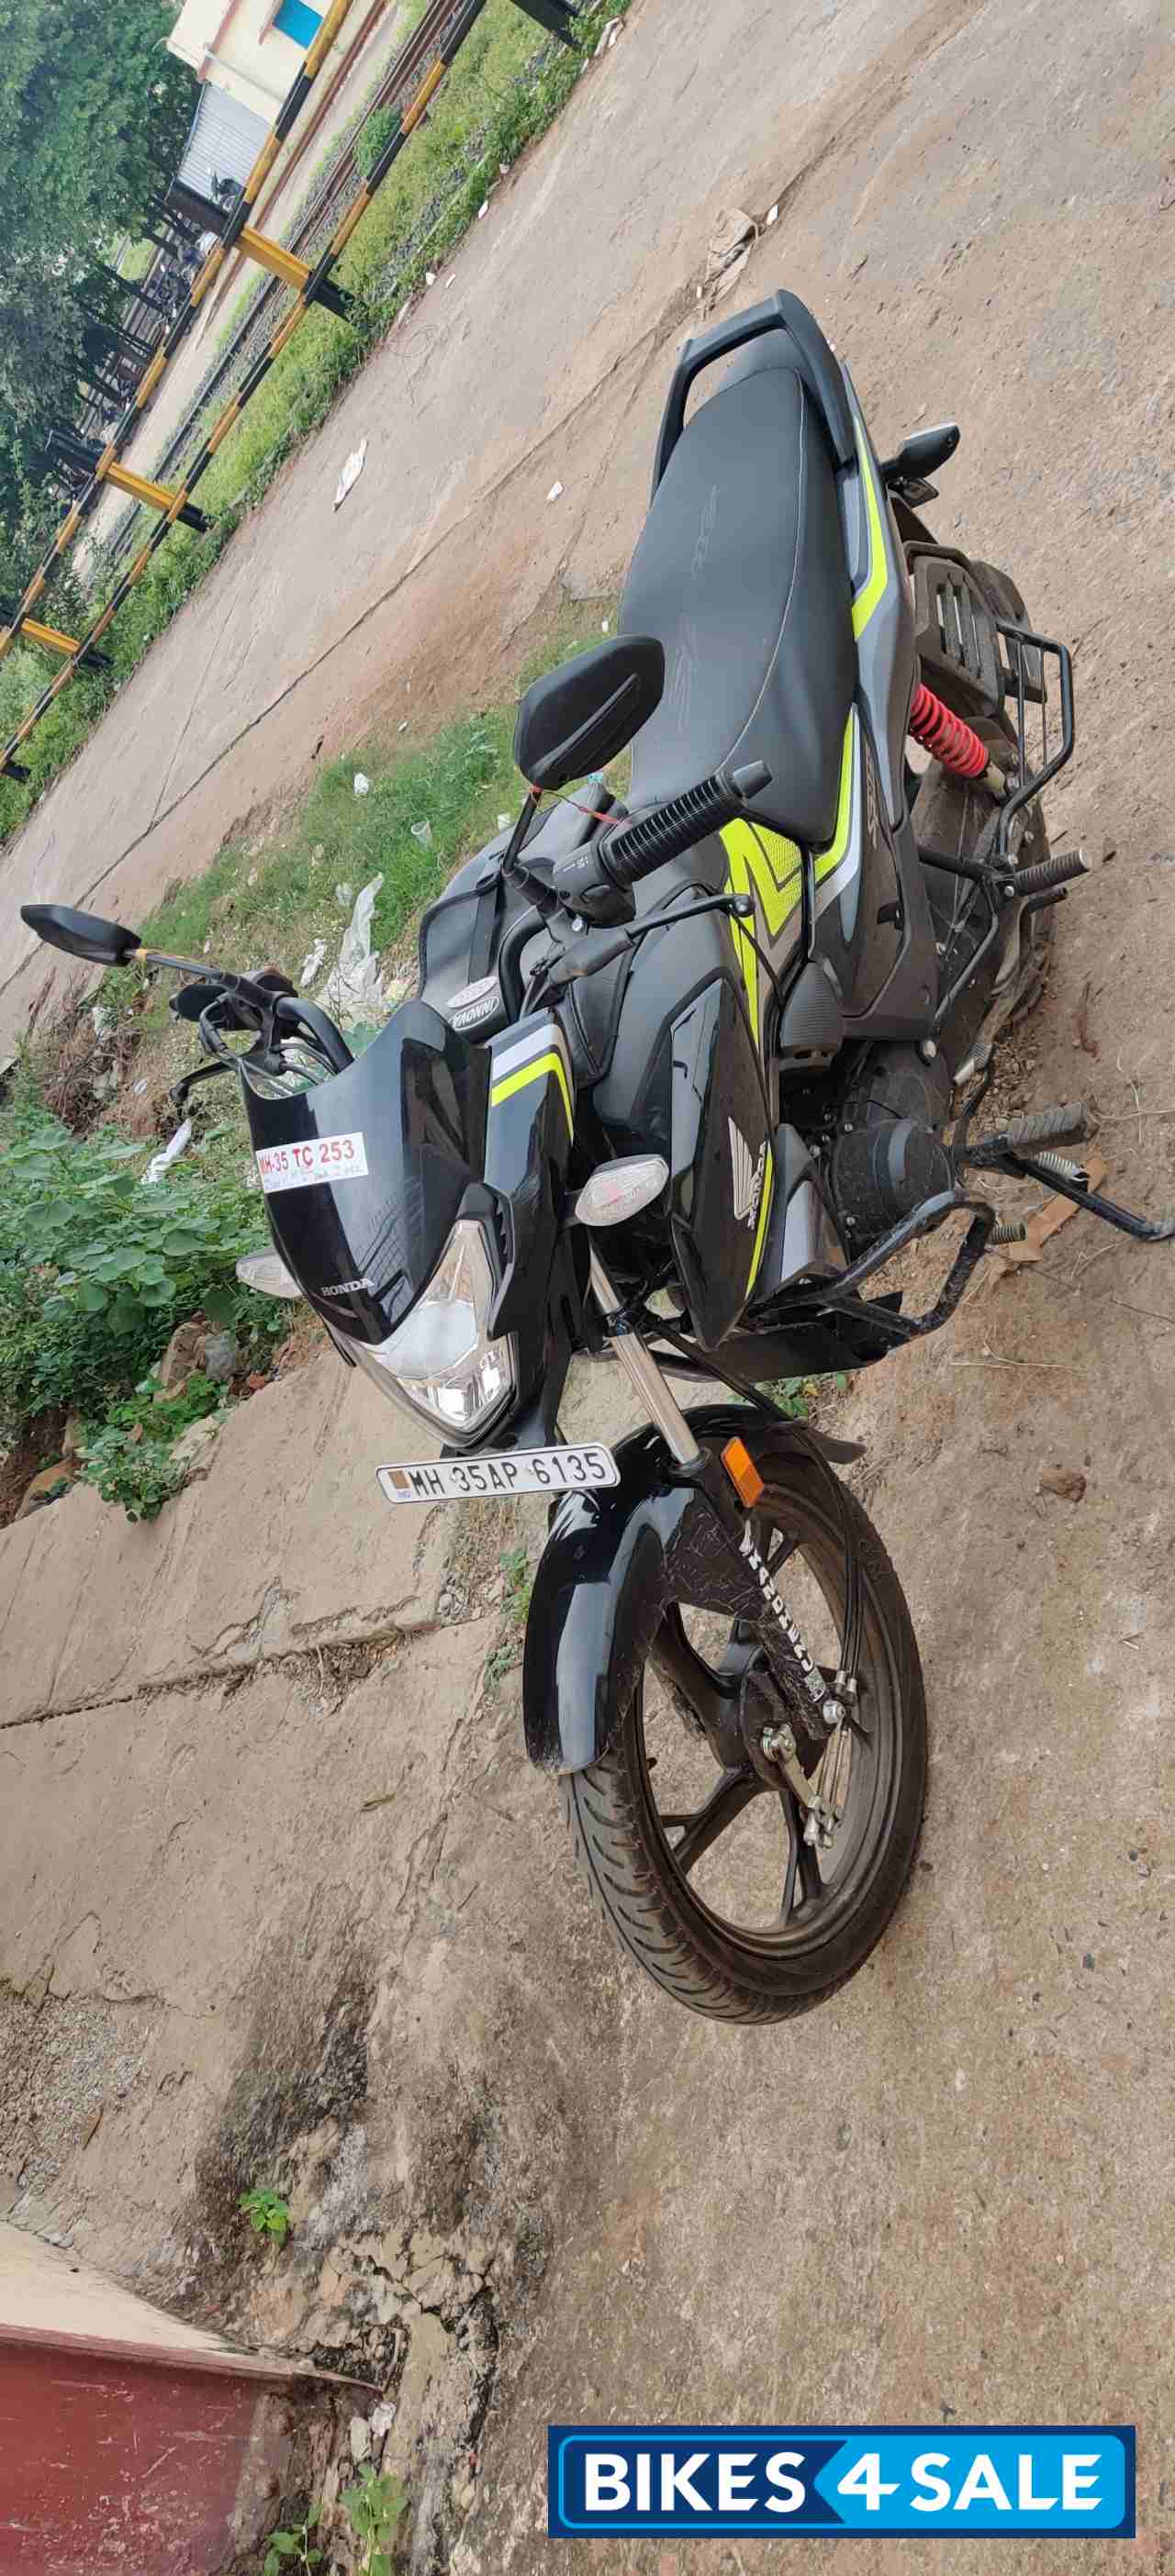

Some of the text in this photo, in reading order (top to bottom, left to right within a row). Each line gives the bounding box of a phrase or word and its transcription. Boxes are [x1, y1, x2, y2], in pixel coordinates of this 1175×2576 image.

[292, 1145, 314, 1168] TC
[319, 1139, 355, 1164] 253
[319, 1277, 375, 1297] HONDA
[408, 1452, 606, 1496] MH 35AP 6135
